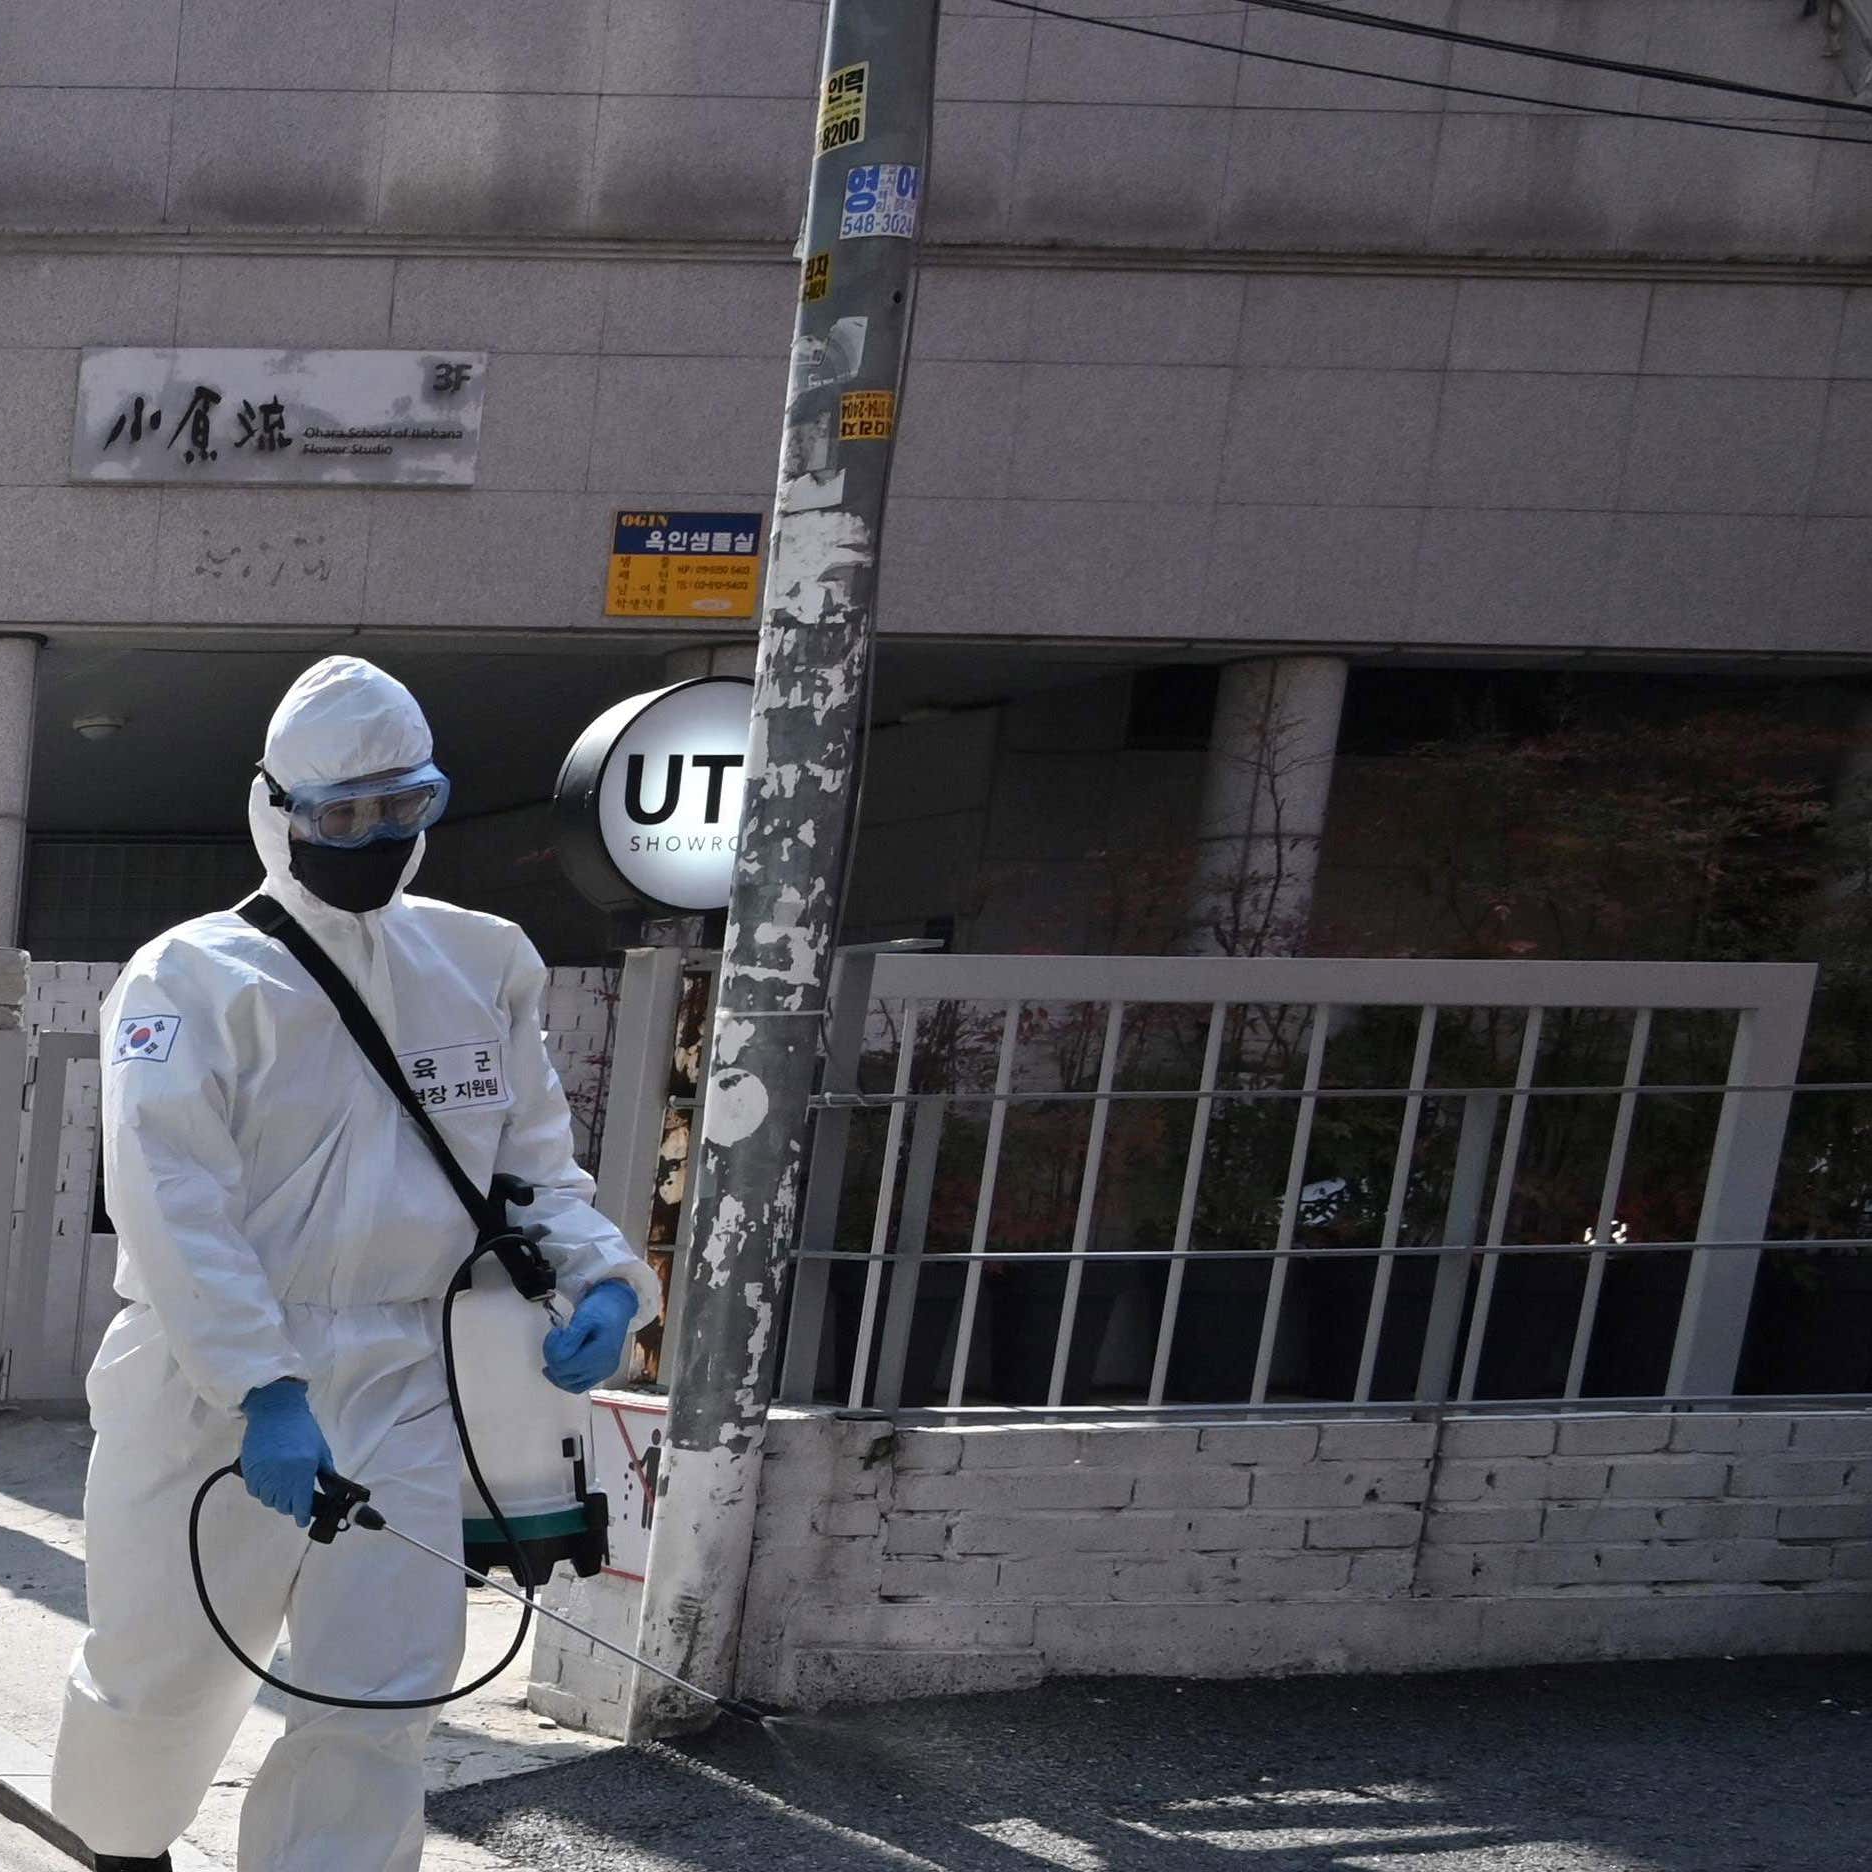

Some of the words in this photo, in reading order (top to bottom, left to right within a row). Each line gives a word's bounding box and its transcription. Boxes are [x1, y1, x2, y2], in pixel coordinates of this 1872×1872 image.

[433, 363, 473, 392] 3F
[304, 427, 344, 439] Ohara
[348, 427, 391, 439] School
[394, 427, 408, 439] of
[303, 444, 346, 455] Flower
[351, 444, 393, 455] Studio
[412, 1058, 437, 1079] 육
[474, 1050, 491, 1072] 군
[455, 1077, 498, 1099] 지원팀
